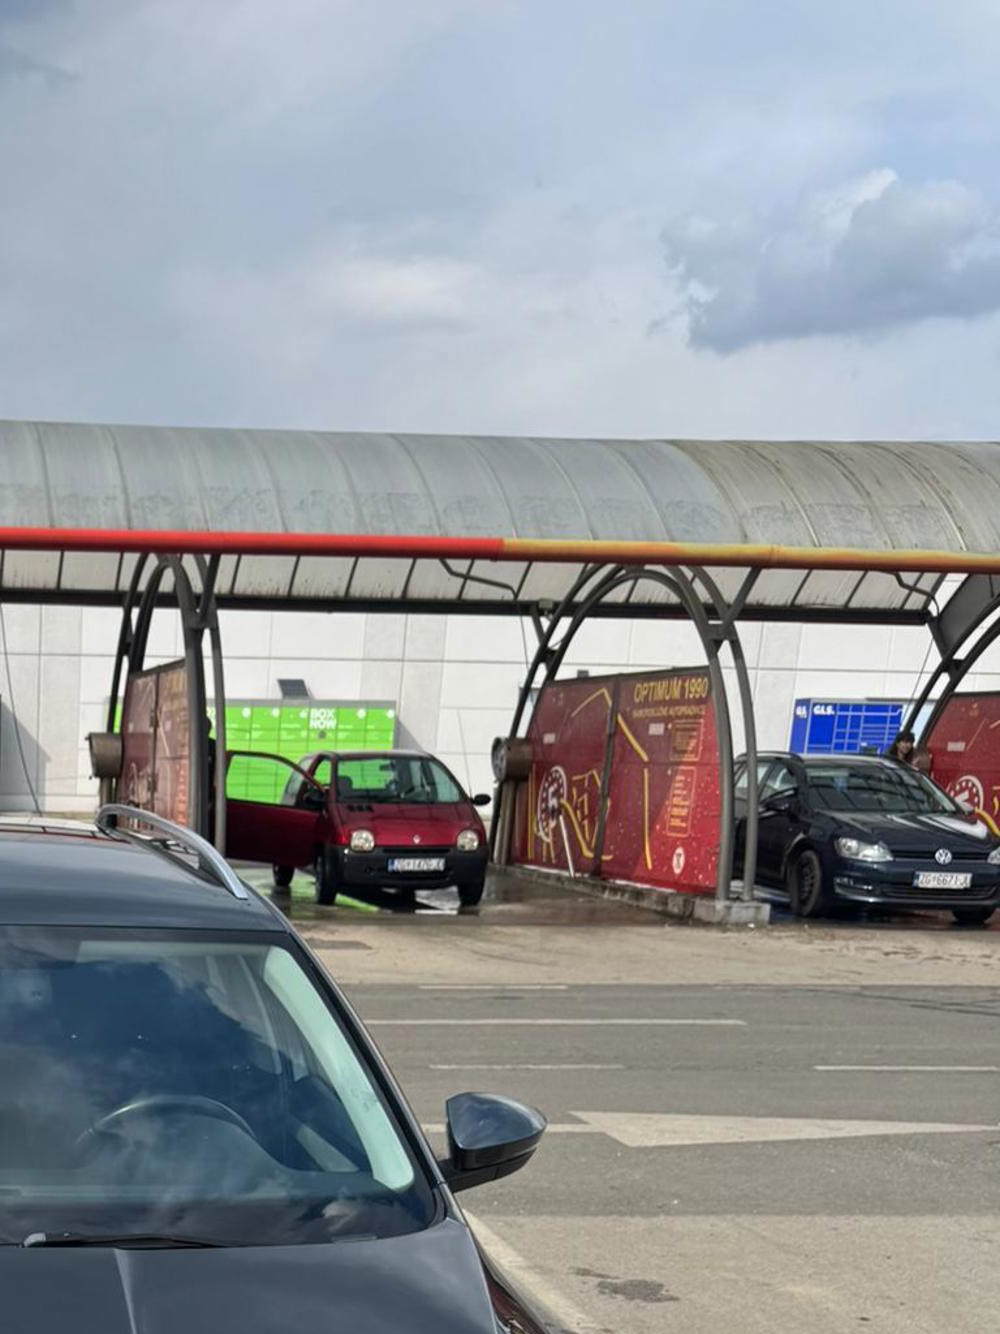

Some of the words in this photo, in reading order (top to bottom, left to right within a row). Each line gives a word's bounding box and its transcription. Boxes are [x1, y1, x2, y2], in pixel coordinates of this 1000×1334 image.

[633, 678, 681, 702] OPTIMUM
[684, 677, 709, 700] 1990
[311, 708, 335, 718] BOX
[310, 718, 337, 730] NOW
